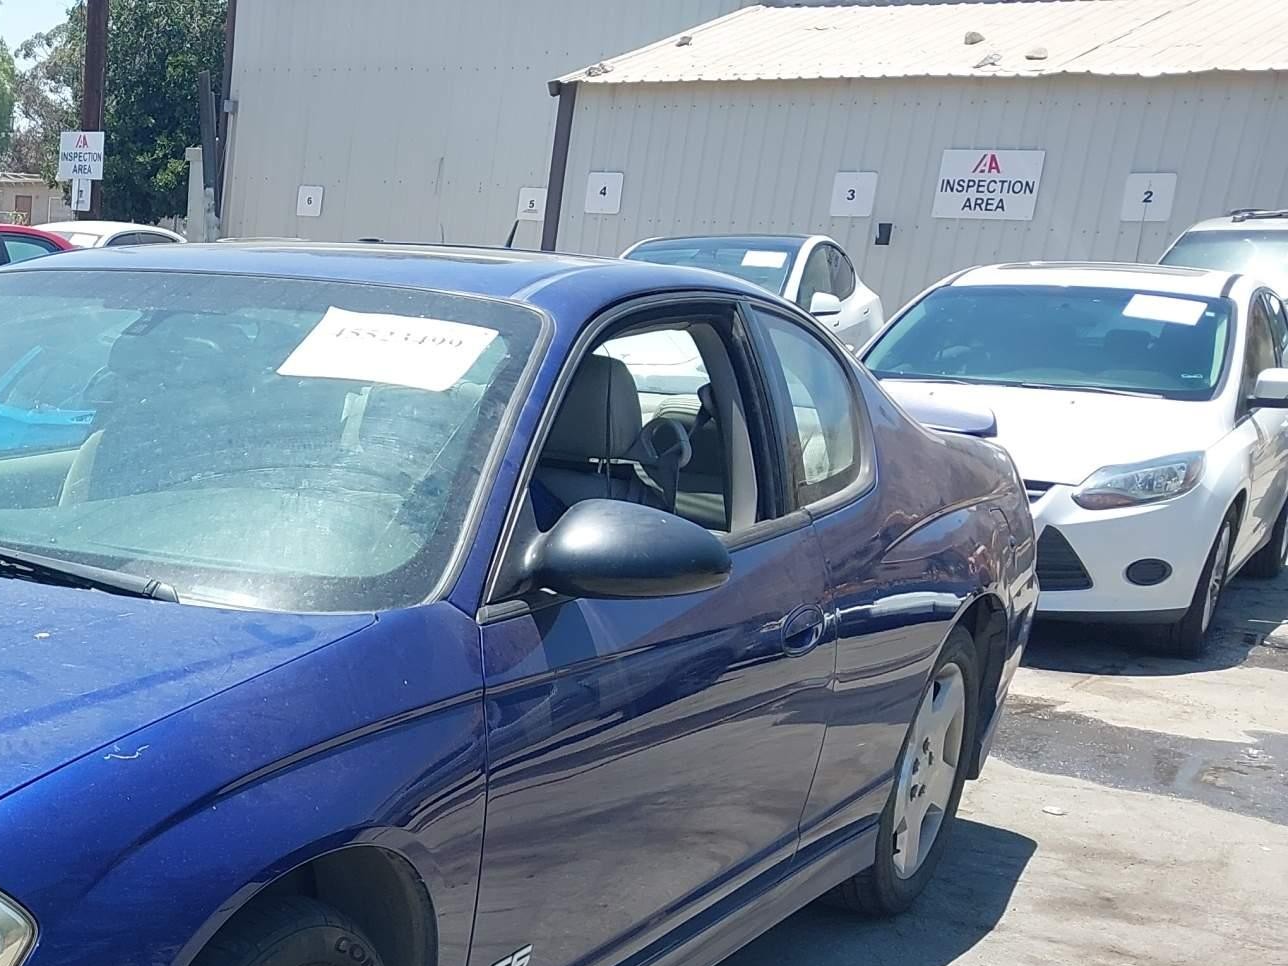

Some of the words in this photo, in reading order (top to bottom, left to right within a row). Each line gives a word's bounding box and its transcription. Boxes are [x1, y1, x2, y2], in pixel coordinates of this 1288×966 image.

[61, 151, 103, 163] INSPECTION
[72, 164, 92, 175] AREA
[599, 186, 607, 196] 4
[939, 178, 1036, 195] INSPECTION
[846, 188, 856, 201] 3
[1141, 190, 1154, 204] 2
[306, 196, 313, 206] 6
[528, 199, 536, 209] 5
[960, 197, 1006, 212] AREA
